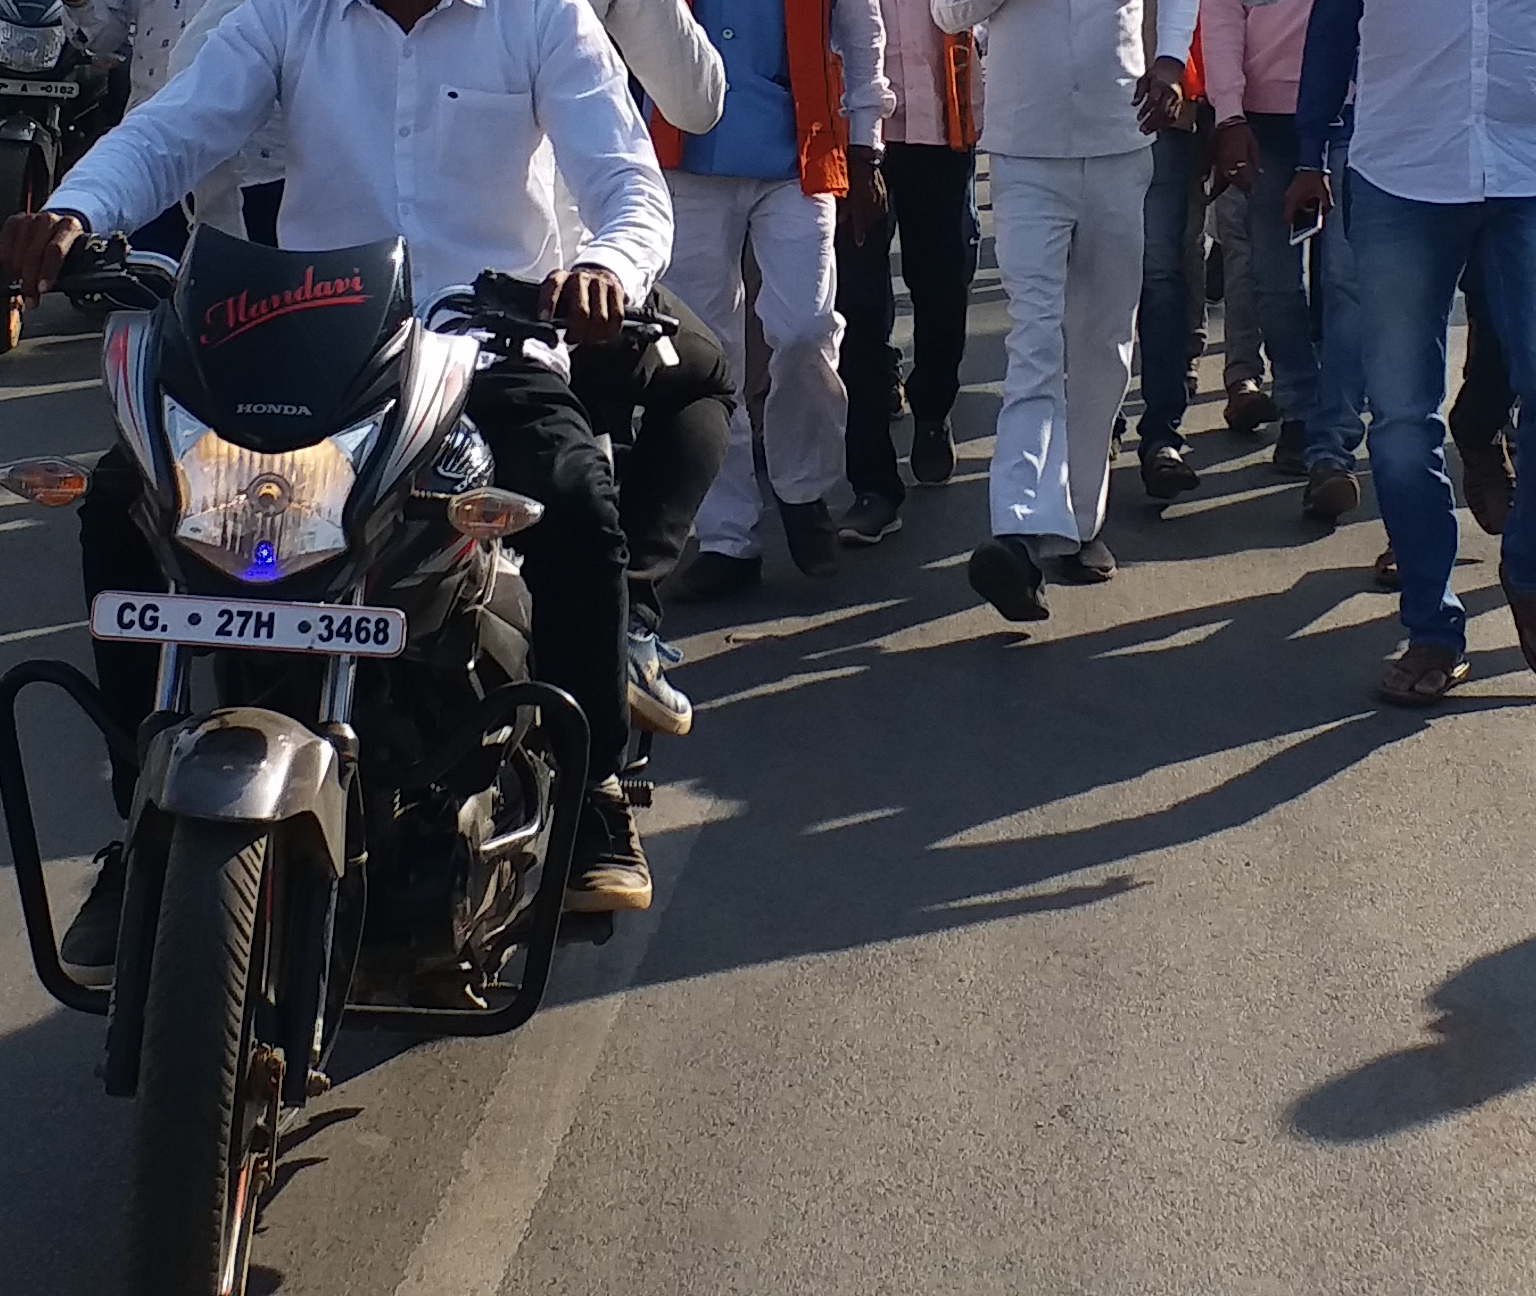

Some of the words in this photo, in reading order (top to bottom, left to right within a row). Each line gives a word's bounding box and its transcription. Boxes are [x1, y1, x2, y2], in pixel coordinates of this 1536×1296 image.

[199, 266, 365, 345] Mandavi
[235, 402, 312, 417] HONDA
[215, 608, 275, 639] 27H
[318, 614, 390, 646] 3468
